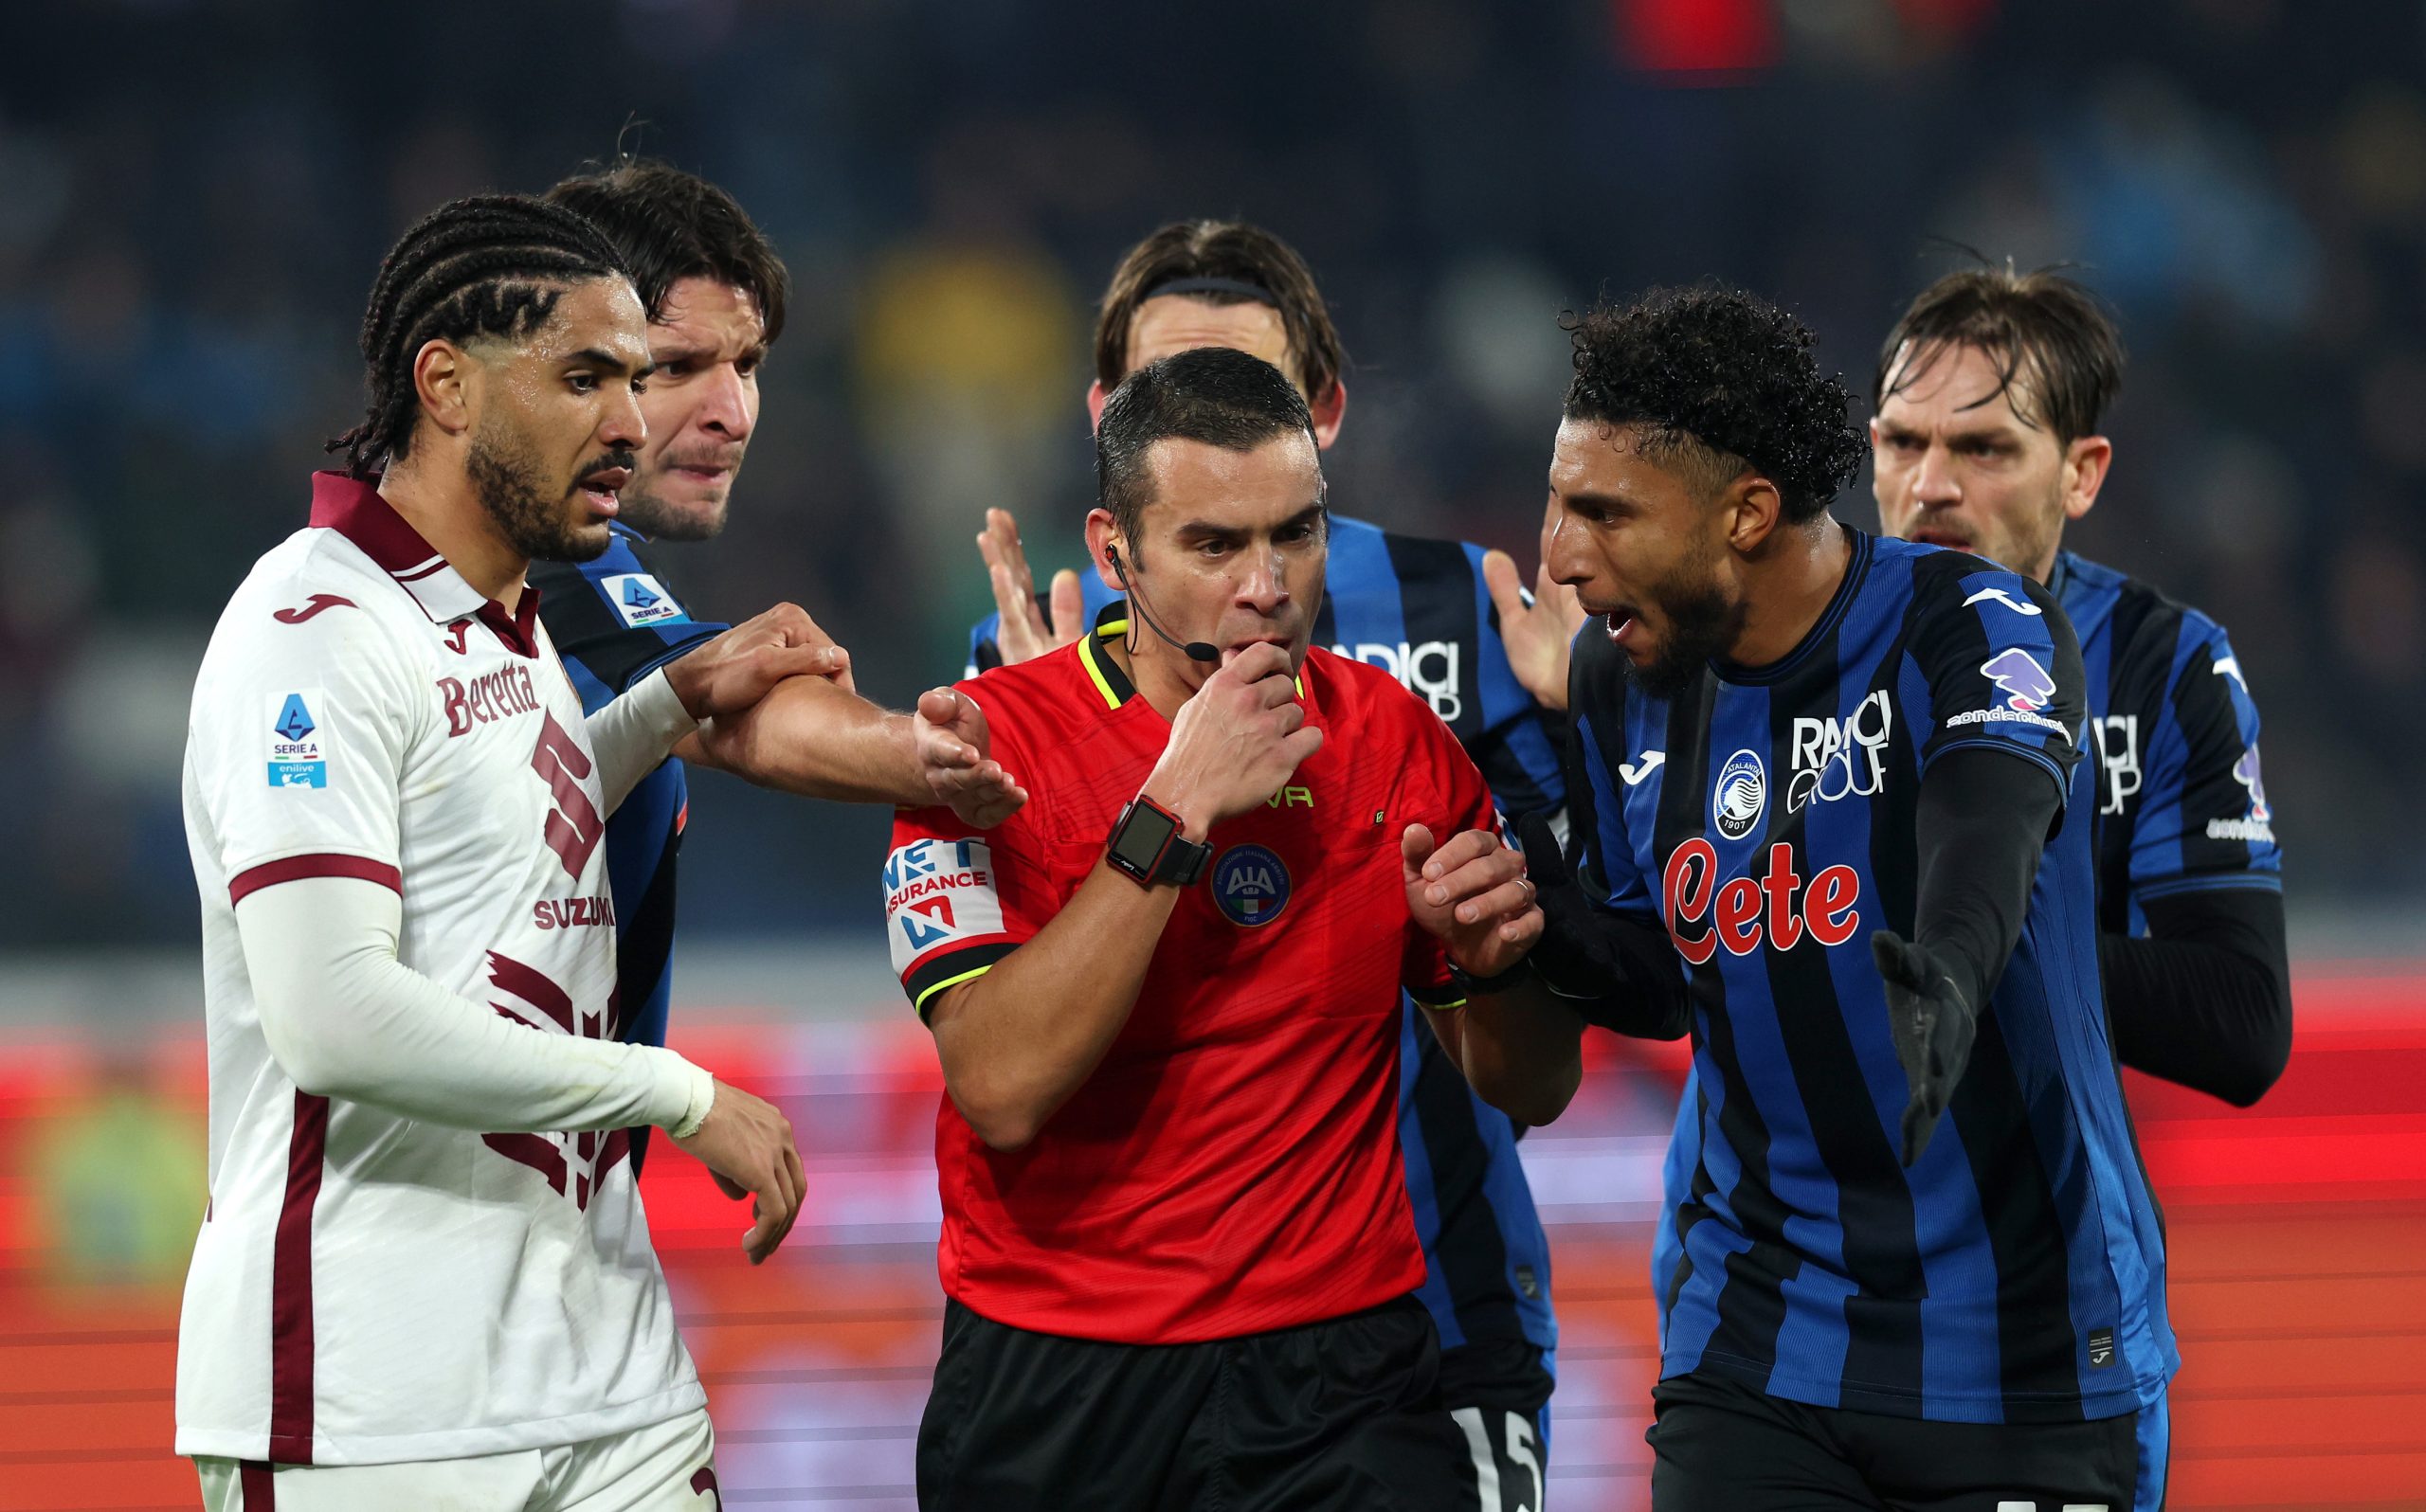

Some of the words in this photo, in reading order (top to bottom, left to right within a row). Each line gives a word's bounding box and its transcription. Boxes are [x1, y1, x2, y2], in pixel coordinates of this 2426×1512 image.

[631, 606, 662, 620] SERIE
[436, 658, 541, 738] Beretta
[274, 744, 307, 754] SERIE
[309, 743, 318, 753] A
[279, 764, 315, 773] enilive
[1727, 762, 1761, 775] ATALANTA
[1724, 819, 1746, 830] 1907
[1225, 866, 1276, 895] AIA
[1449, 1406, 1543, 1512] 15
